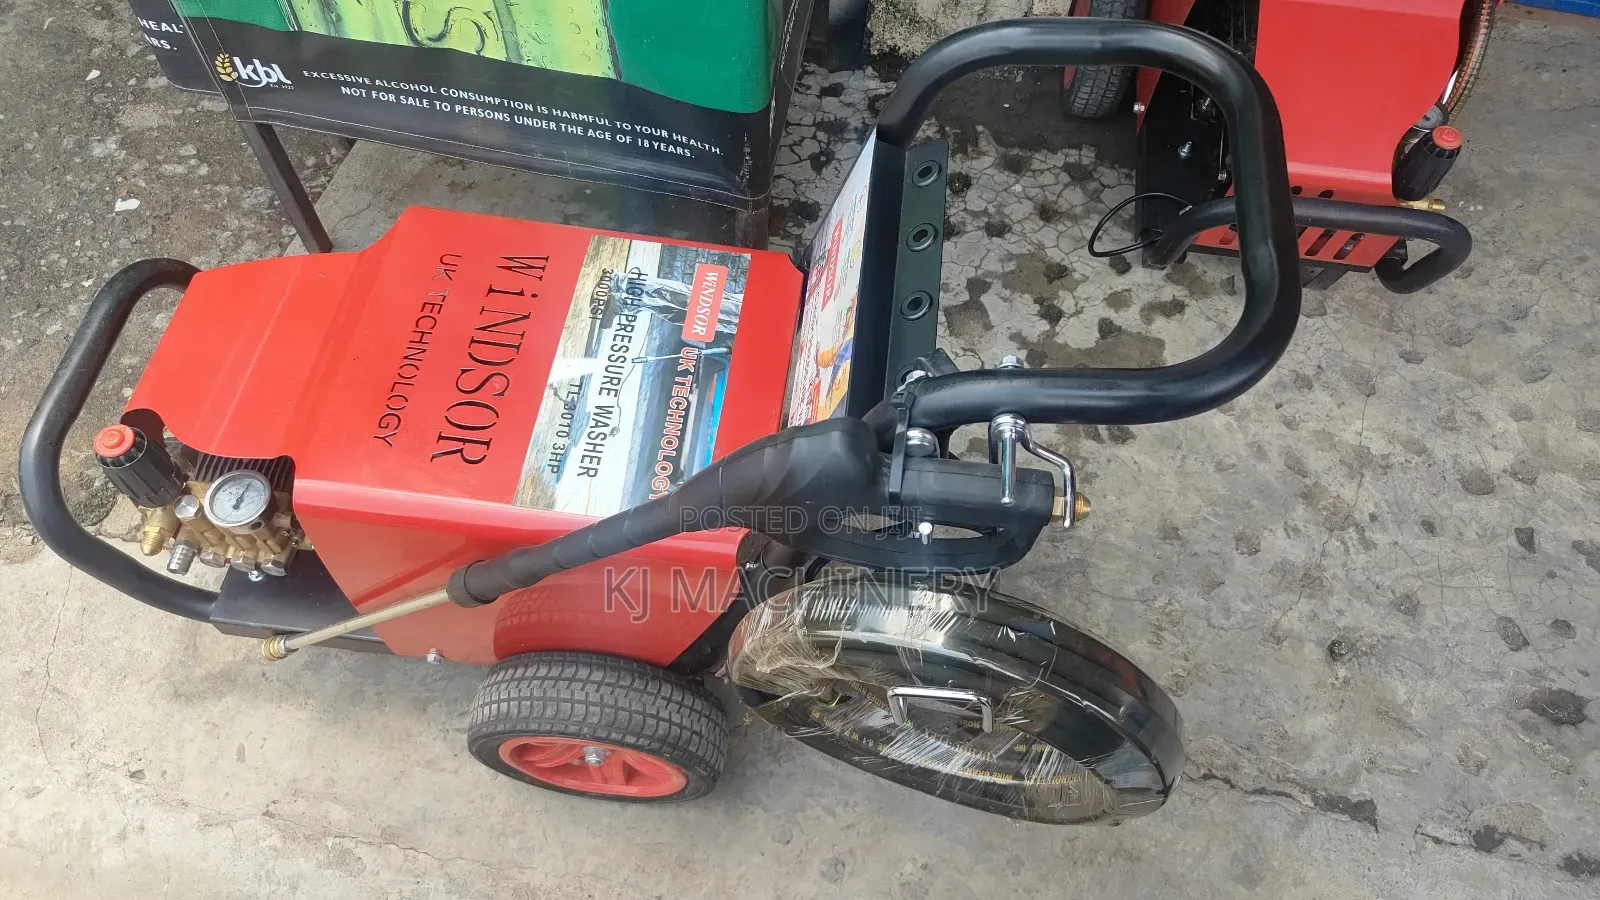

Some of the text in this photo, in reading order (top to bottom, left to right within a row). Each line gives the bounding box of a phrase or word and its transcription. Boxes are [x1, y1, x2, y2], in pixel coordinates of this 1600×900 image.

[137, 16, 184, 34] HEAL
[232, 56, 293, 87] kbl
[303, 70, 724, 156] EXCESSIVE ALCOHOL CONSUMPTION IS HARMFUL TO YOUR HEALTH.
[341, 85, 695, 158] NOT FOR SALE TO PERSONS UNDER THE AGE OF 18 YEARS.
[588, 267, 614, 321] 3000PSI
[373, 253, 462, 447] UK TECHNOLOGY
[577, 271, 649, 478] HIGH PRESSURE WASHER
[677, 347, 699, 373] UK
[547, 442, 566, 474] 3HP
